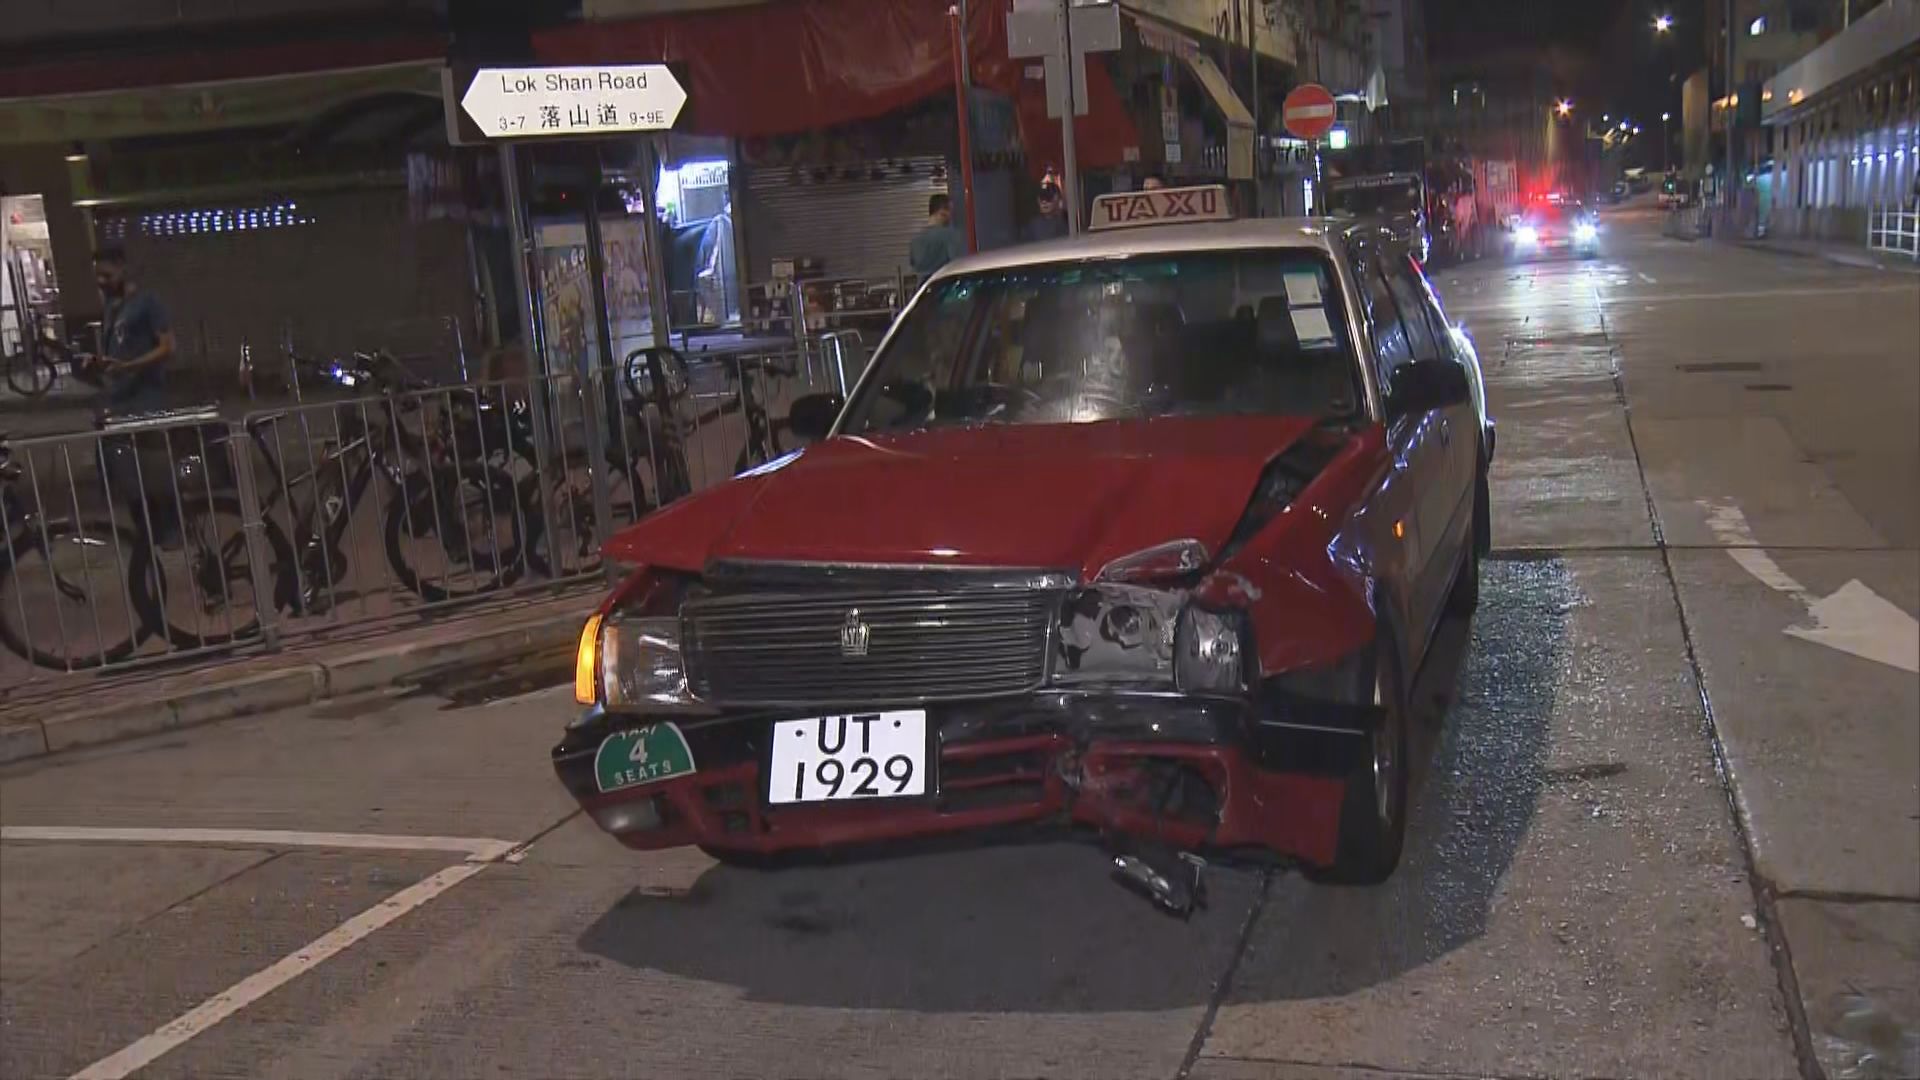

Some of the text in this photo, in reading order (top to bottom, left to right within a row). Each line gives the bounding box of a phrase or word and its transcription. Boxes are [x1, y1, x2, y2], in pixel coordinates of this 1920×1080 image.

[501, 72, 648, 94] Lok Shan Road
[499, 104, 665, 131] 3-7 落山道 9-9E
[1101, 190, 1218, 222] TAXI
[817, 714, 881, 755] UT
[628, 737, 648, 764] 4
[614, 759, 672, 785] SEATS
[795, 754, 914, 801] 1929
